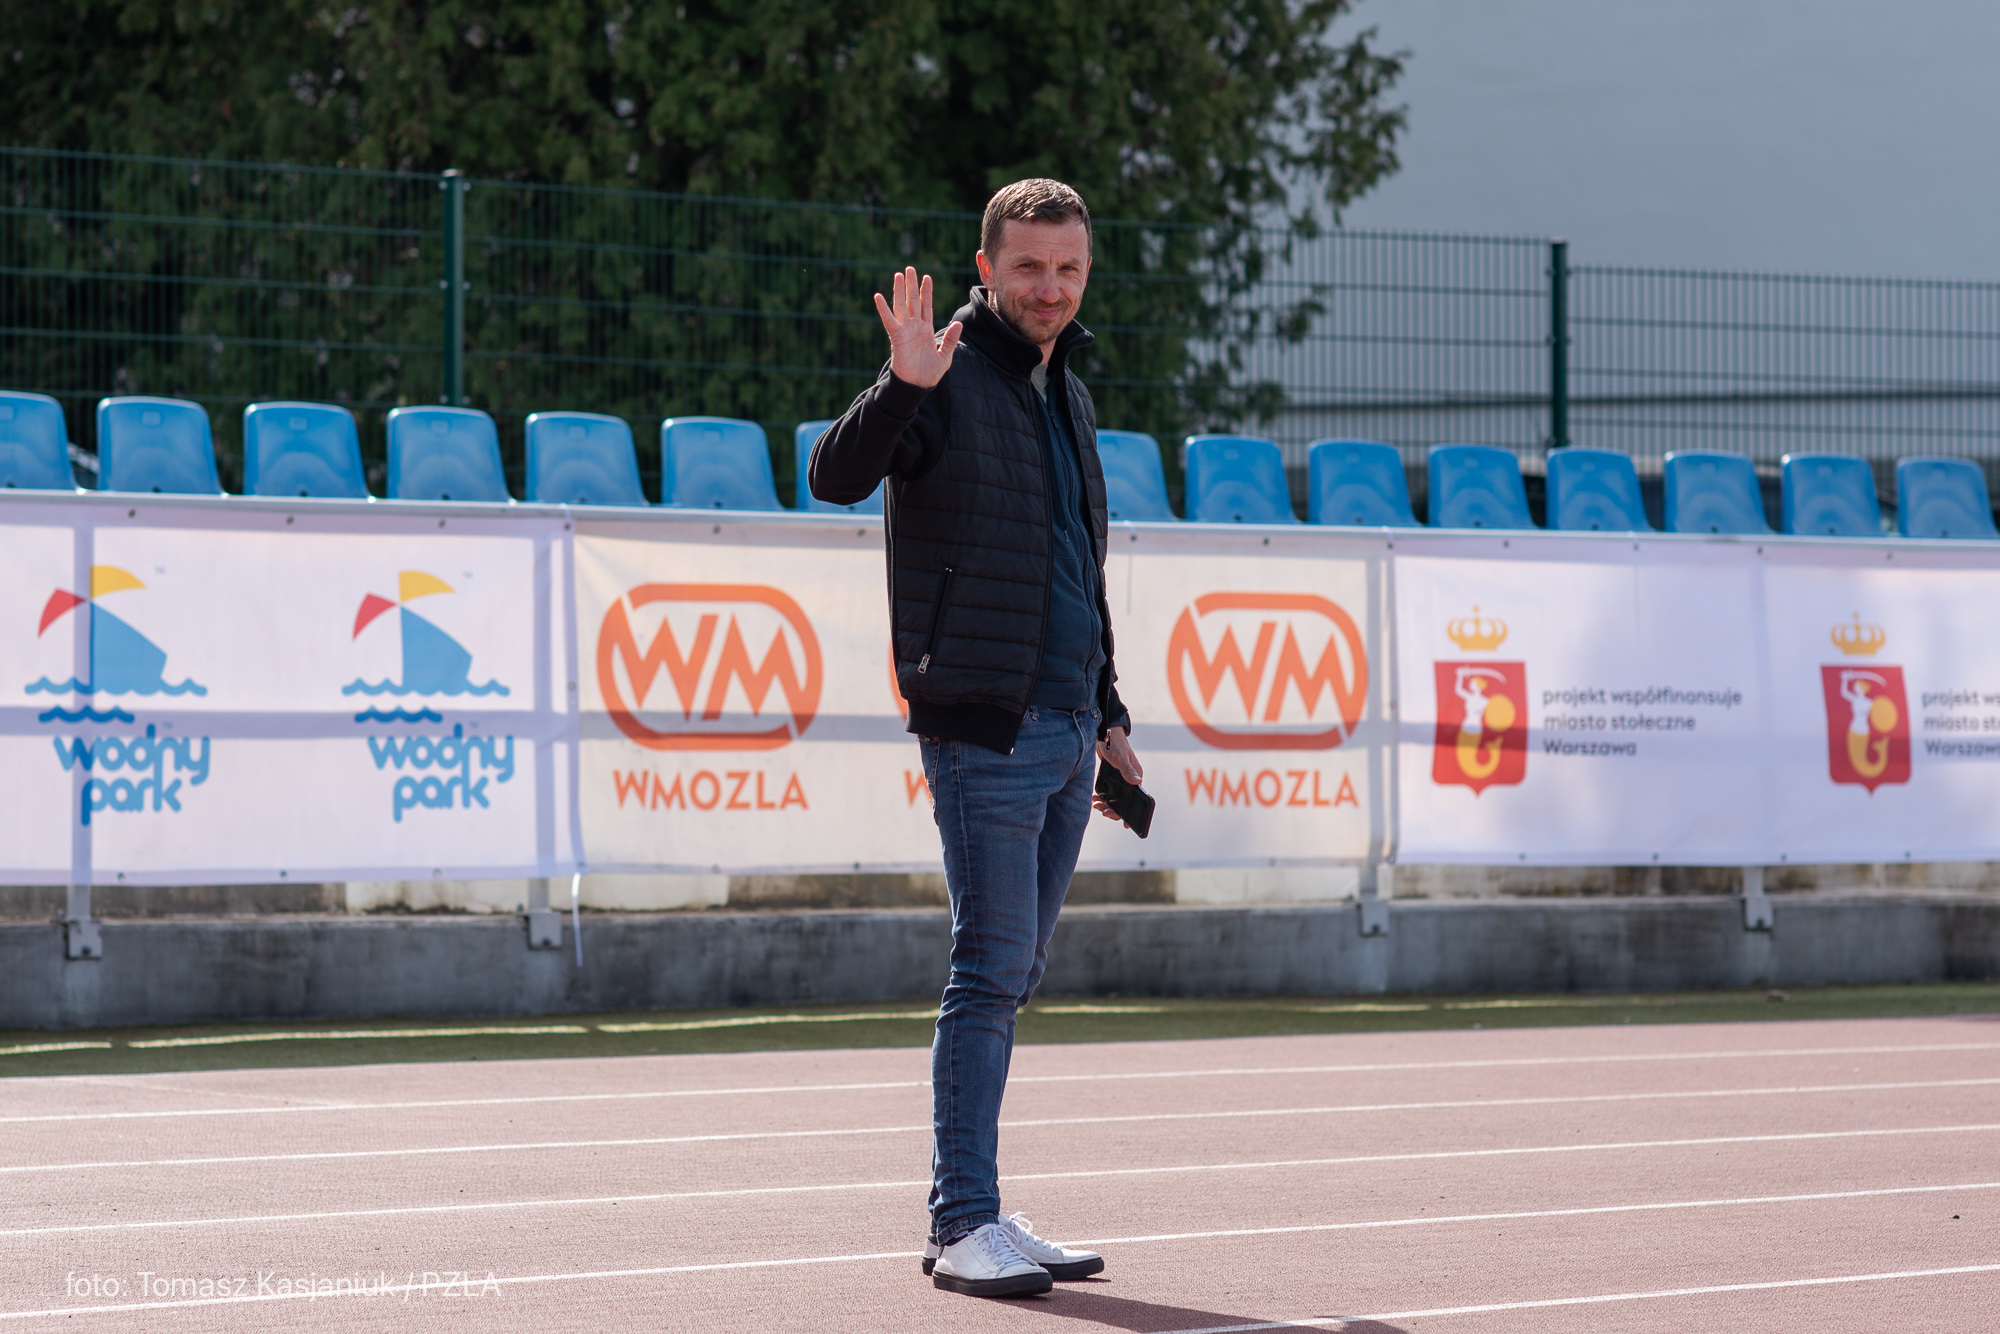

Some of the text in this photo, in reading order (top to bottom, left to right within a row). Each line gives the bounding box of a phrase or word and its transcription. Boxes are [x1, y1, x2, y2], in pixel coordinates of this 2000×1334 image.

[1542, 687, 1742, 710] projekt współfinansuje
[1922, 689, 1979, 710] projekt
[1544, 713, 1695, 731] miasto stołeczne
[1924, 714, 1979, 732] miasto
[53, 722, 210, 787] wodny
[367, 722, 514, 783] wodny
[1542, 739, 1637, 756] Warszawa
[1924, 739, 2000, 757] Warszaw
[81, 777, 182, 826] park
[393, 775, 490, 823] park
[613, 770, 809, 811] WMOZLA
[1184, 768, 1360, 808] WMOZLA
